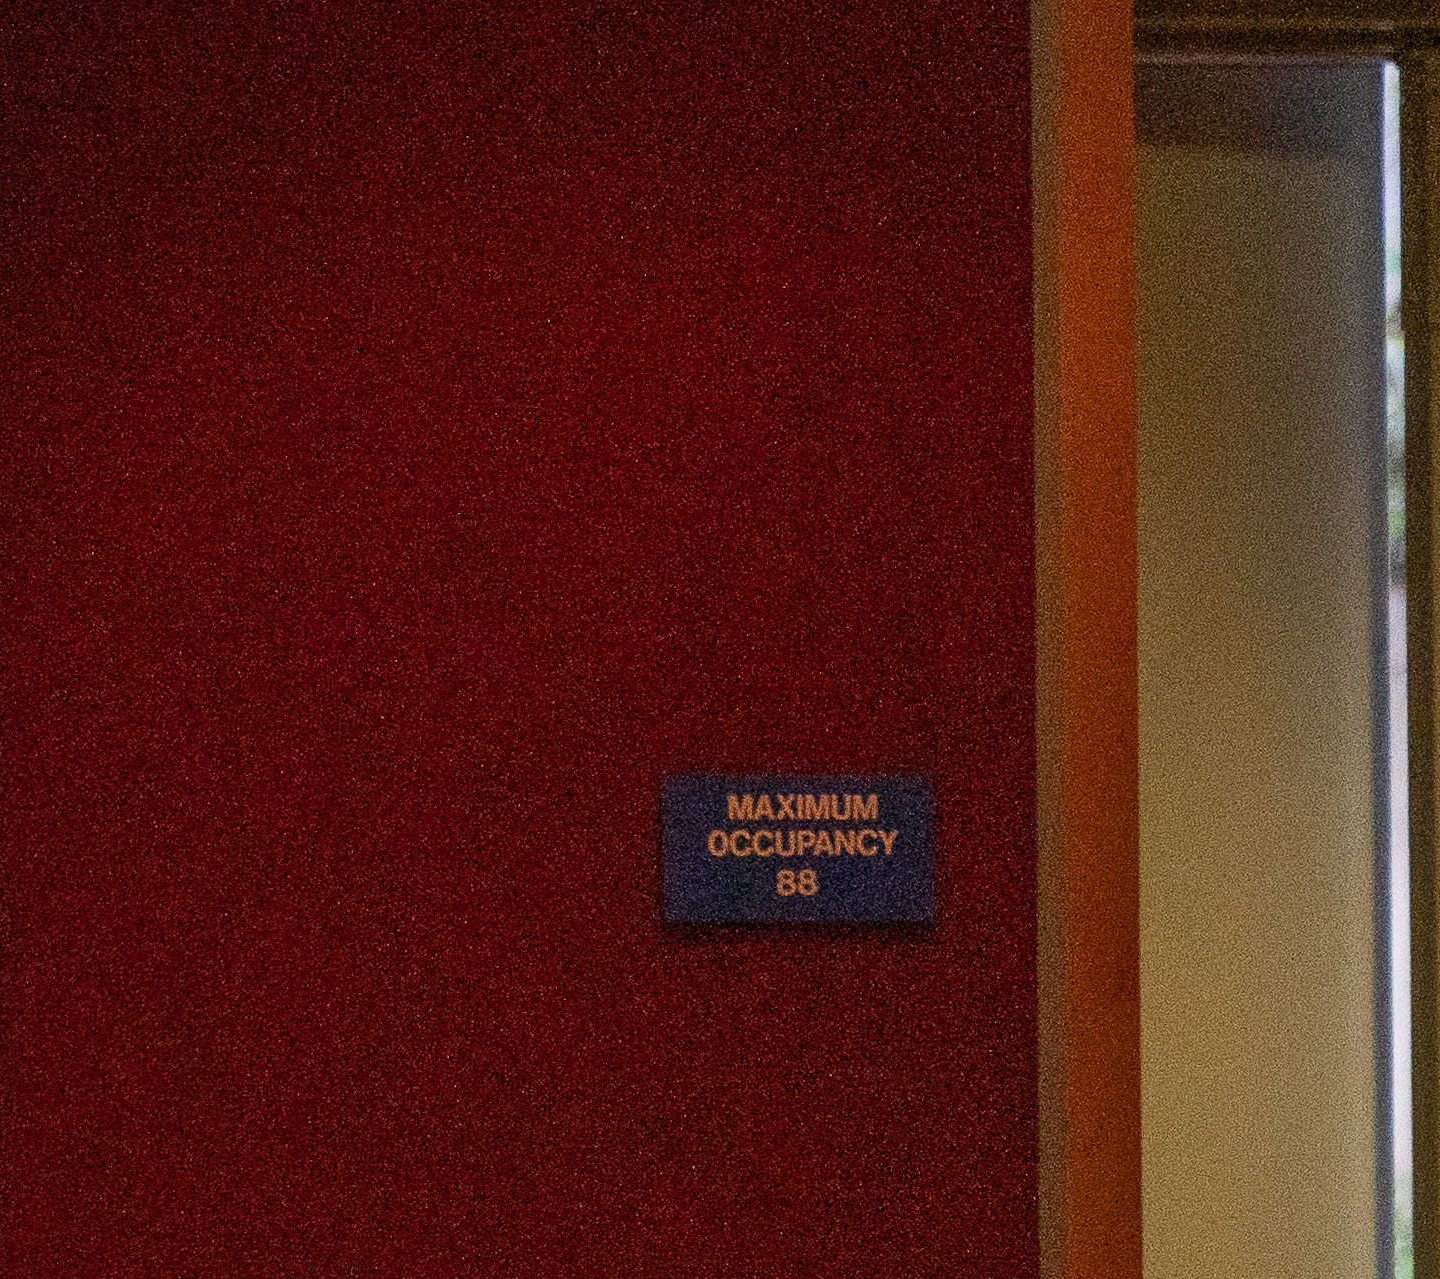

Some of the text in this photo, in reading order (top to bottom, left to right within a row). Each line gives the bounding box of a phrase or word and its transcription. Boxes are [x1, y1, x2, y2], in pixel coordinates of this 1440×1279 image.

[726, 793, 879, 820] MAXIMUM
[707, 828, 898, 857] OCCUPANCY
[776, 869, 819, 896] 88
